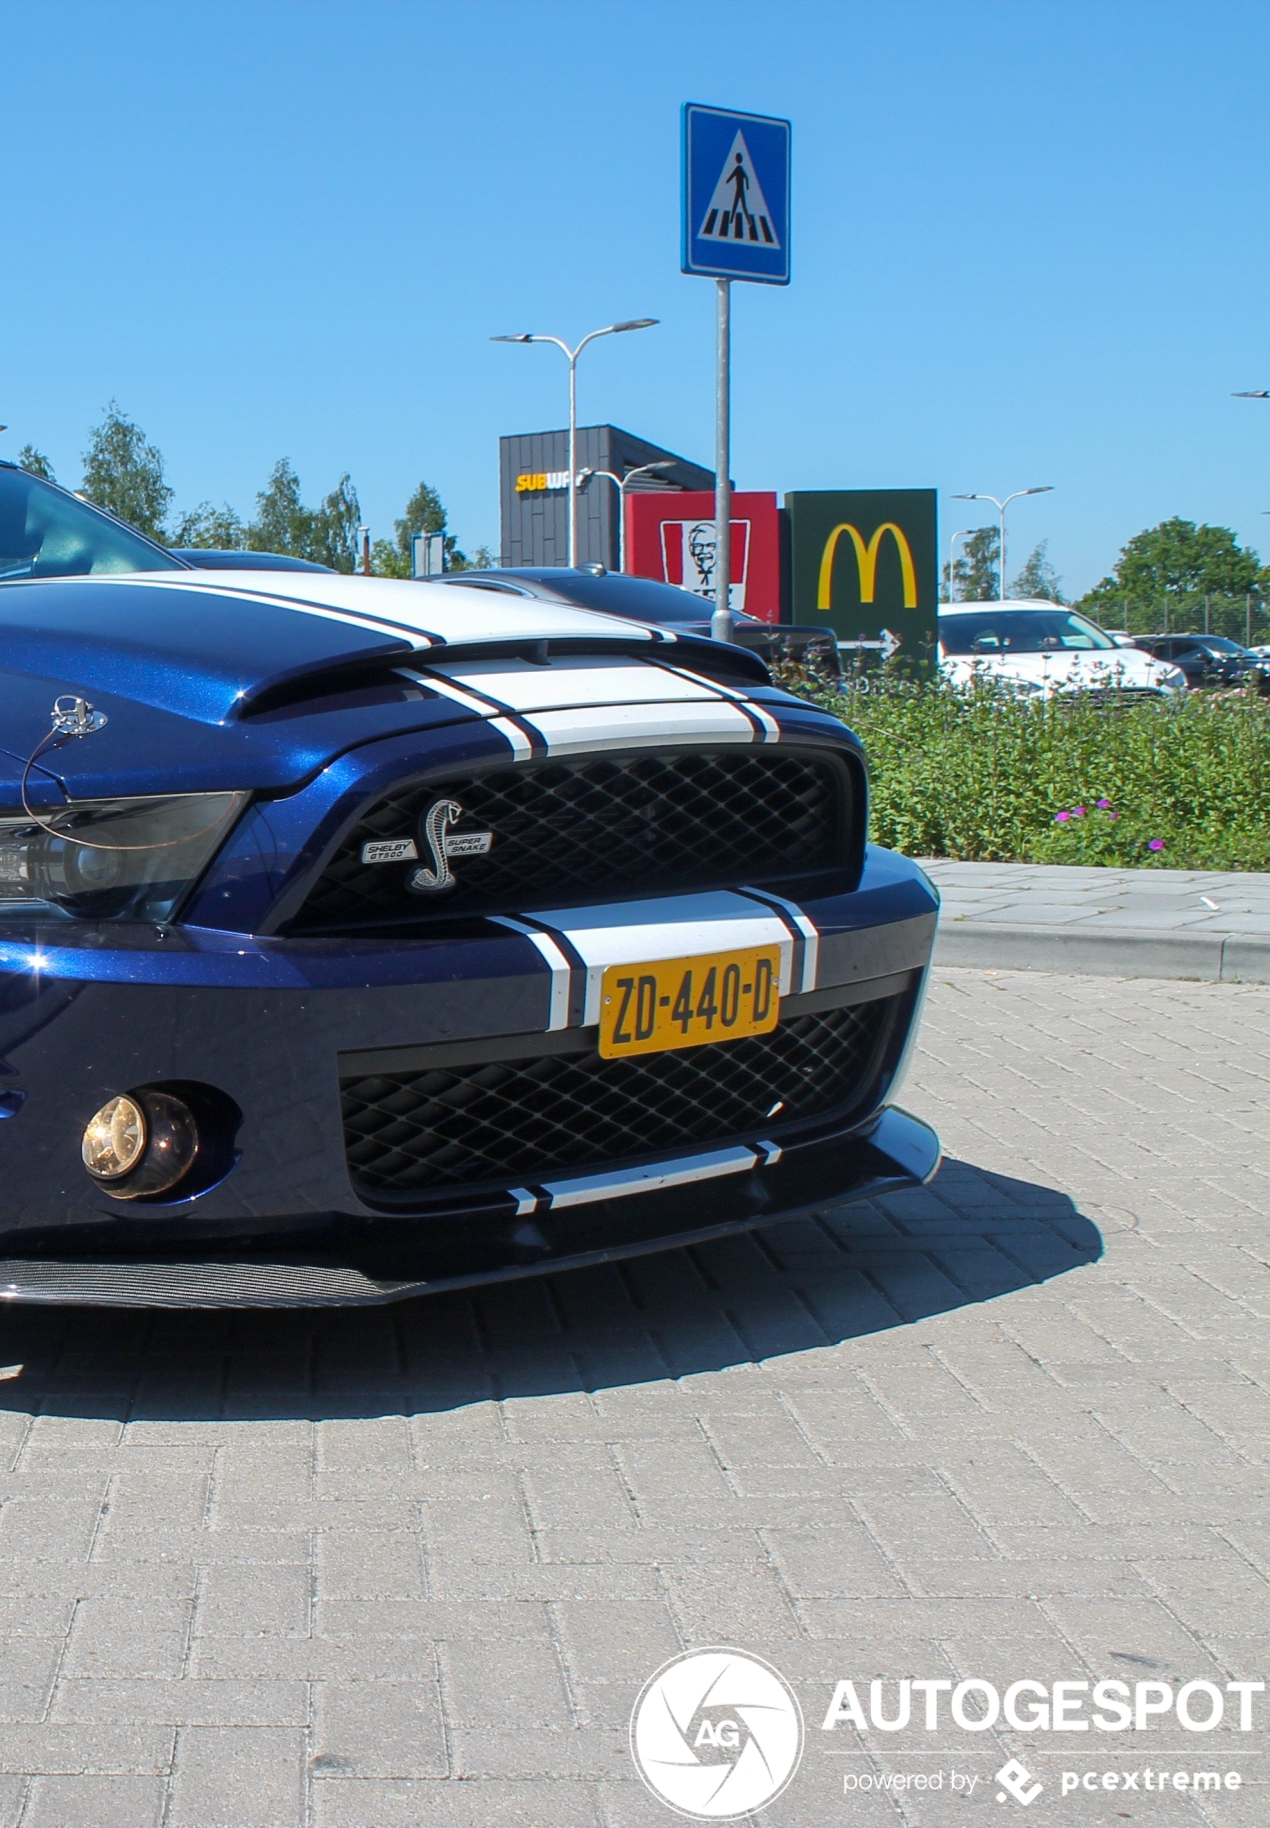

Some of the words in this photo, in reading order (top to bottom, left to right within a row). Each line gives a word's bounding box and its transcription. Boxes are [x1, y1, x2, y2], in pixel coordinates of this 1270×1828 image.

[447, 837, 482, 847] SUPER
[367, 843, 409, 854] SHELBY
[451, 843, 487, 853] SNAKE
[370, 851, 403, 860] GT500
[612, 958, 773, 1045] ZD-440-D
